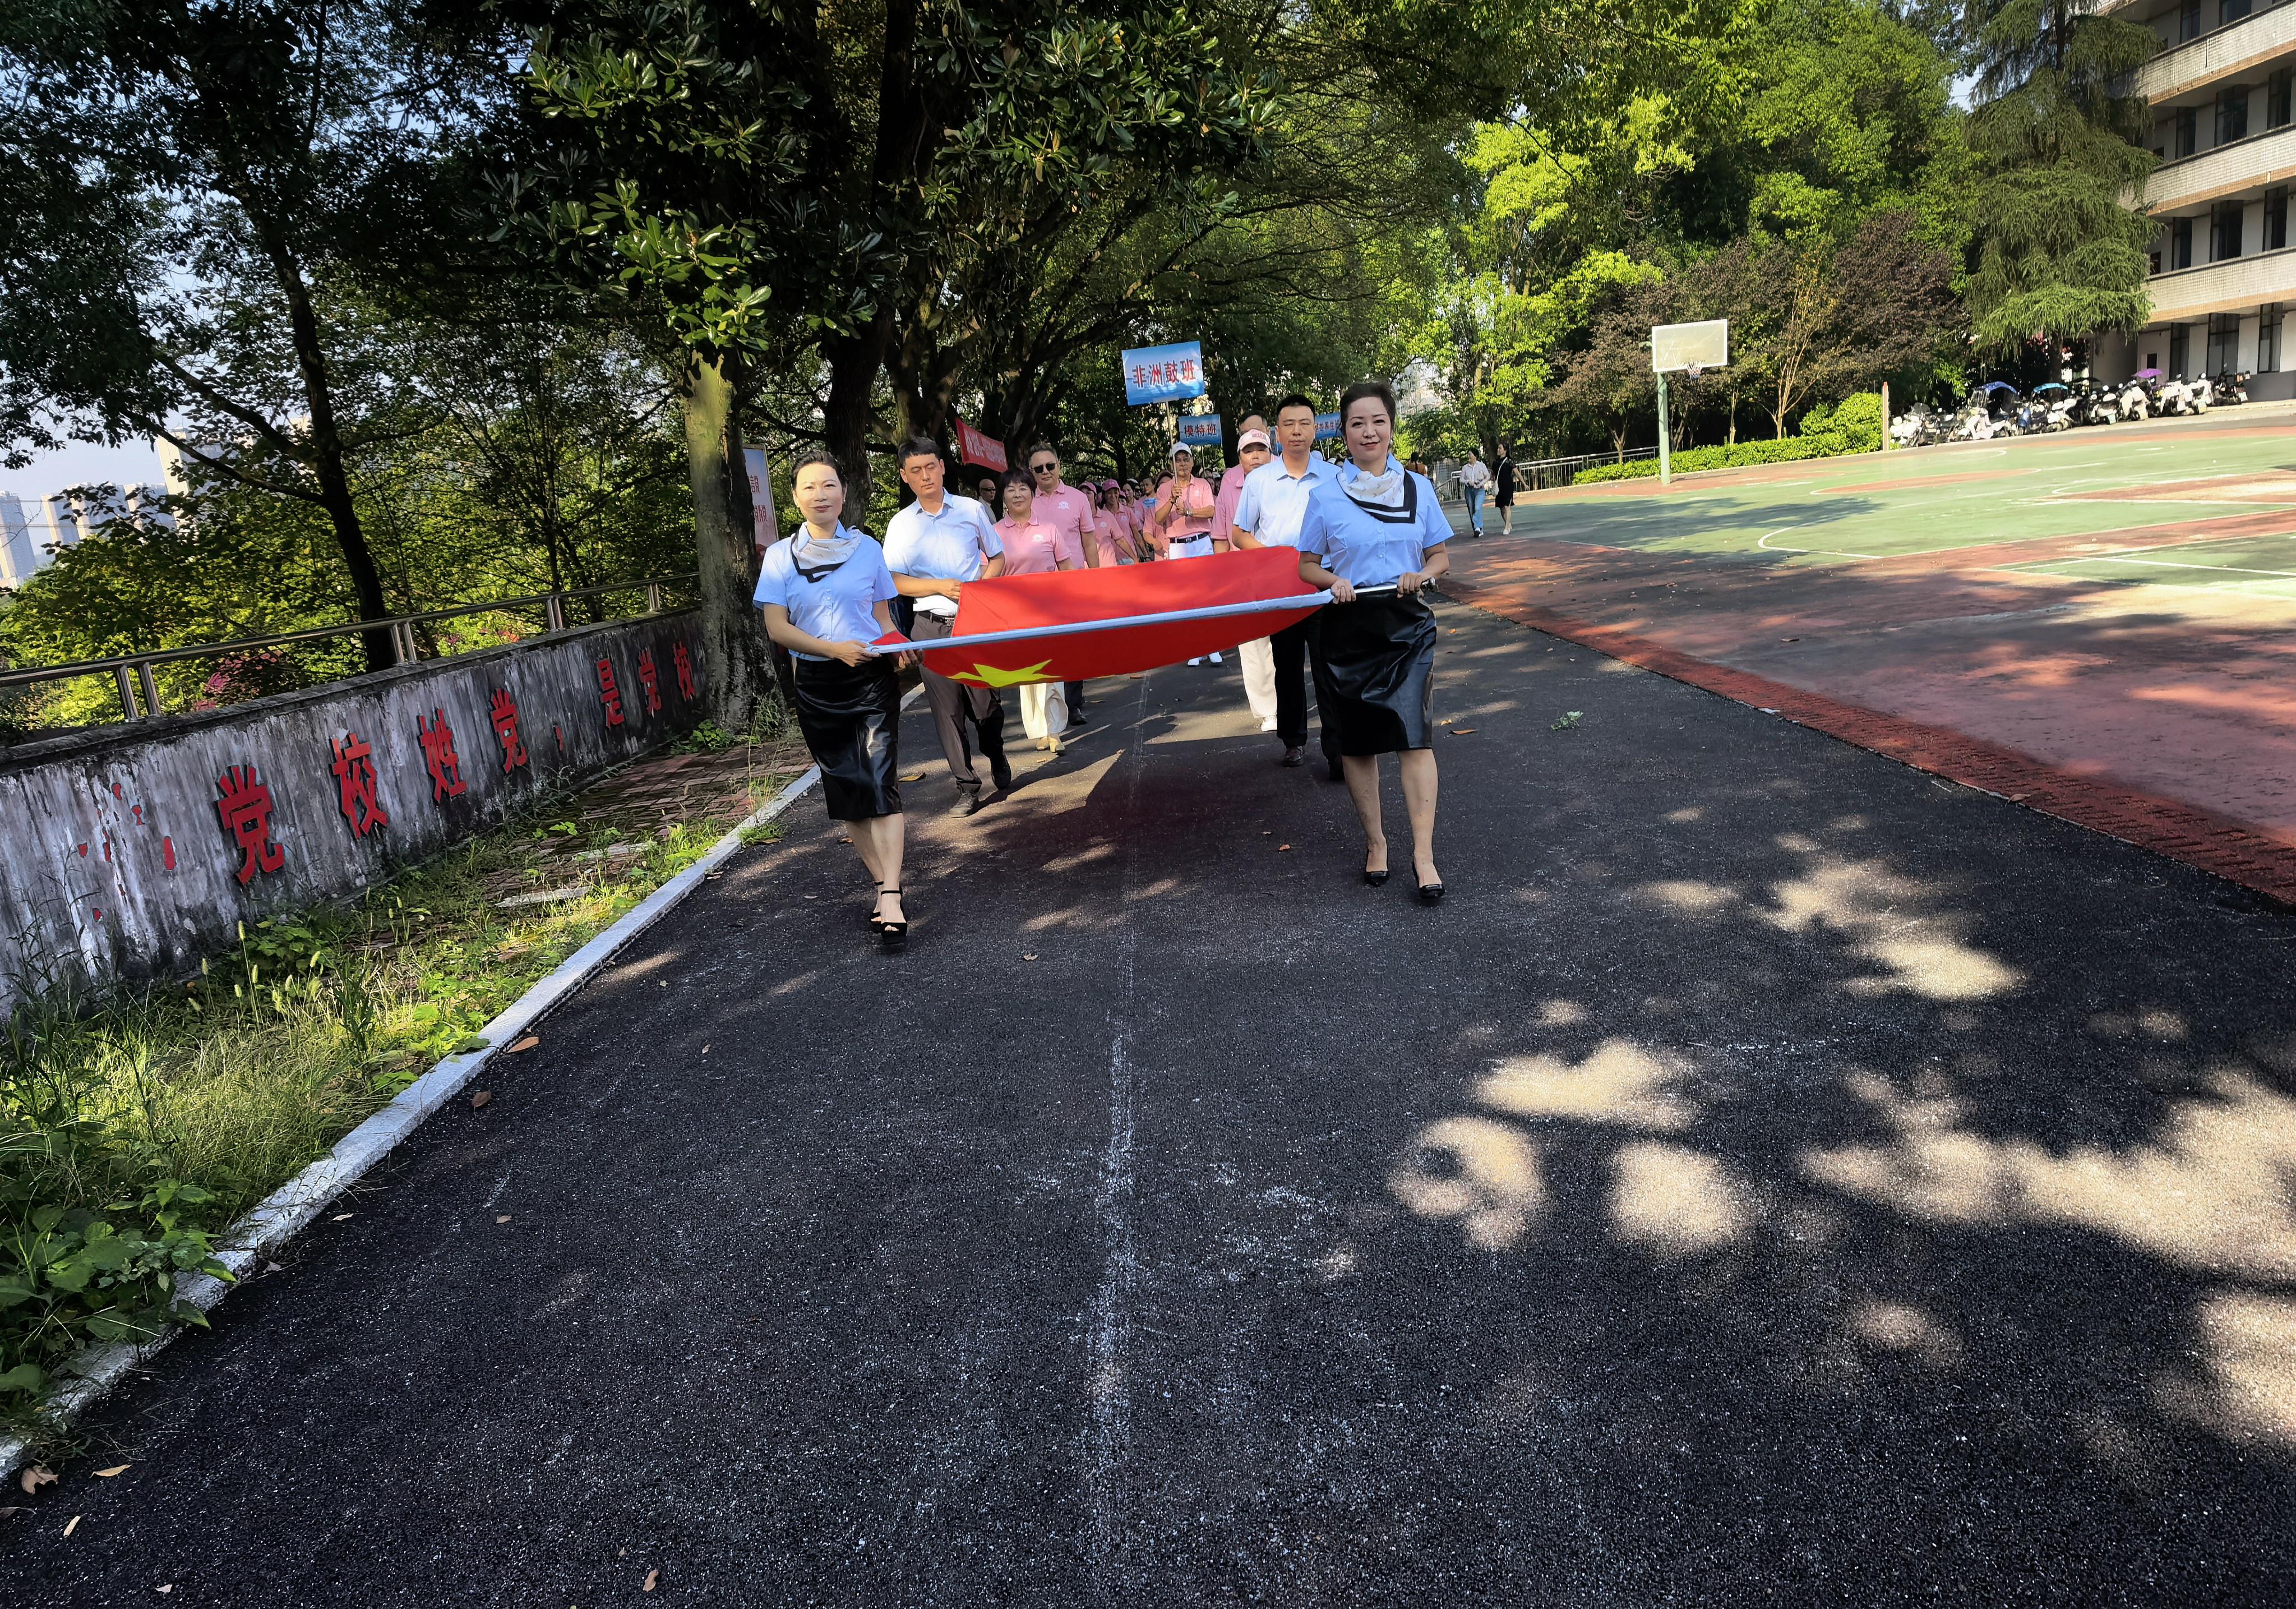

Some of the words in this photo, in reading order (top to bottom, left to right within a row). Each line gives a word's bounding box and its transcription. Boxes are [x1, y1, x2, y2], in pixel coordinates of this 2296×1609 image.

[1131, 358, 1196, 389] 非洲鼓班
[1184, 423, 1218, 437] 模特班
